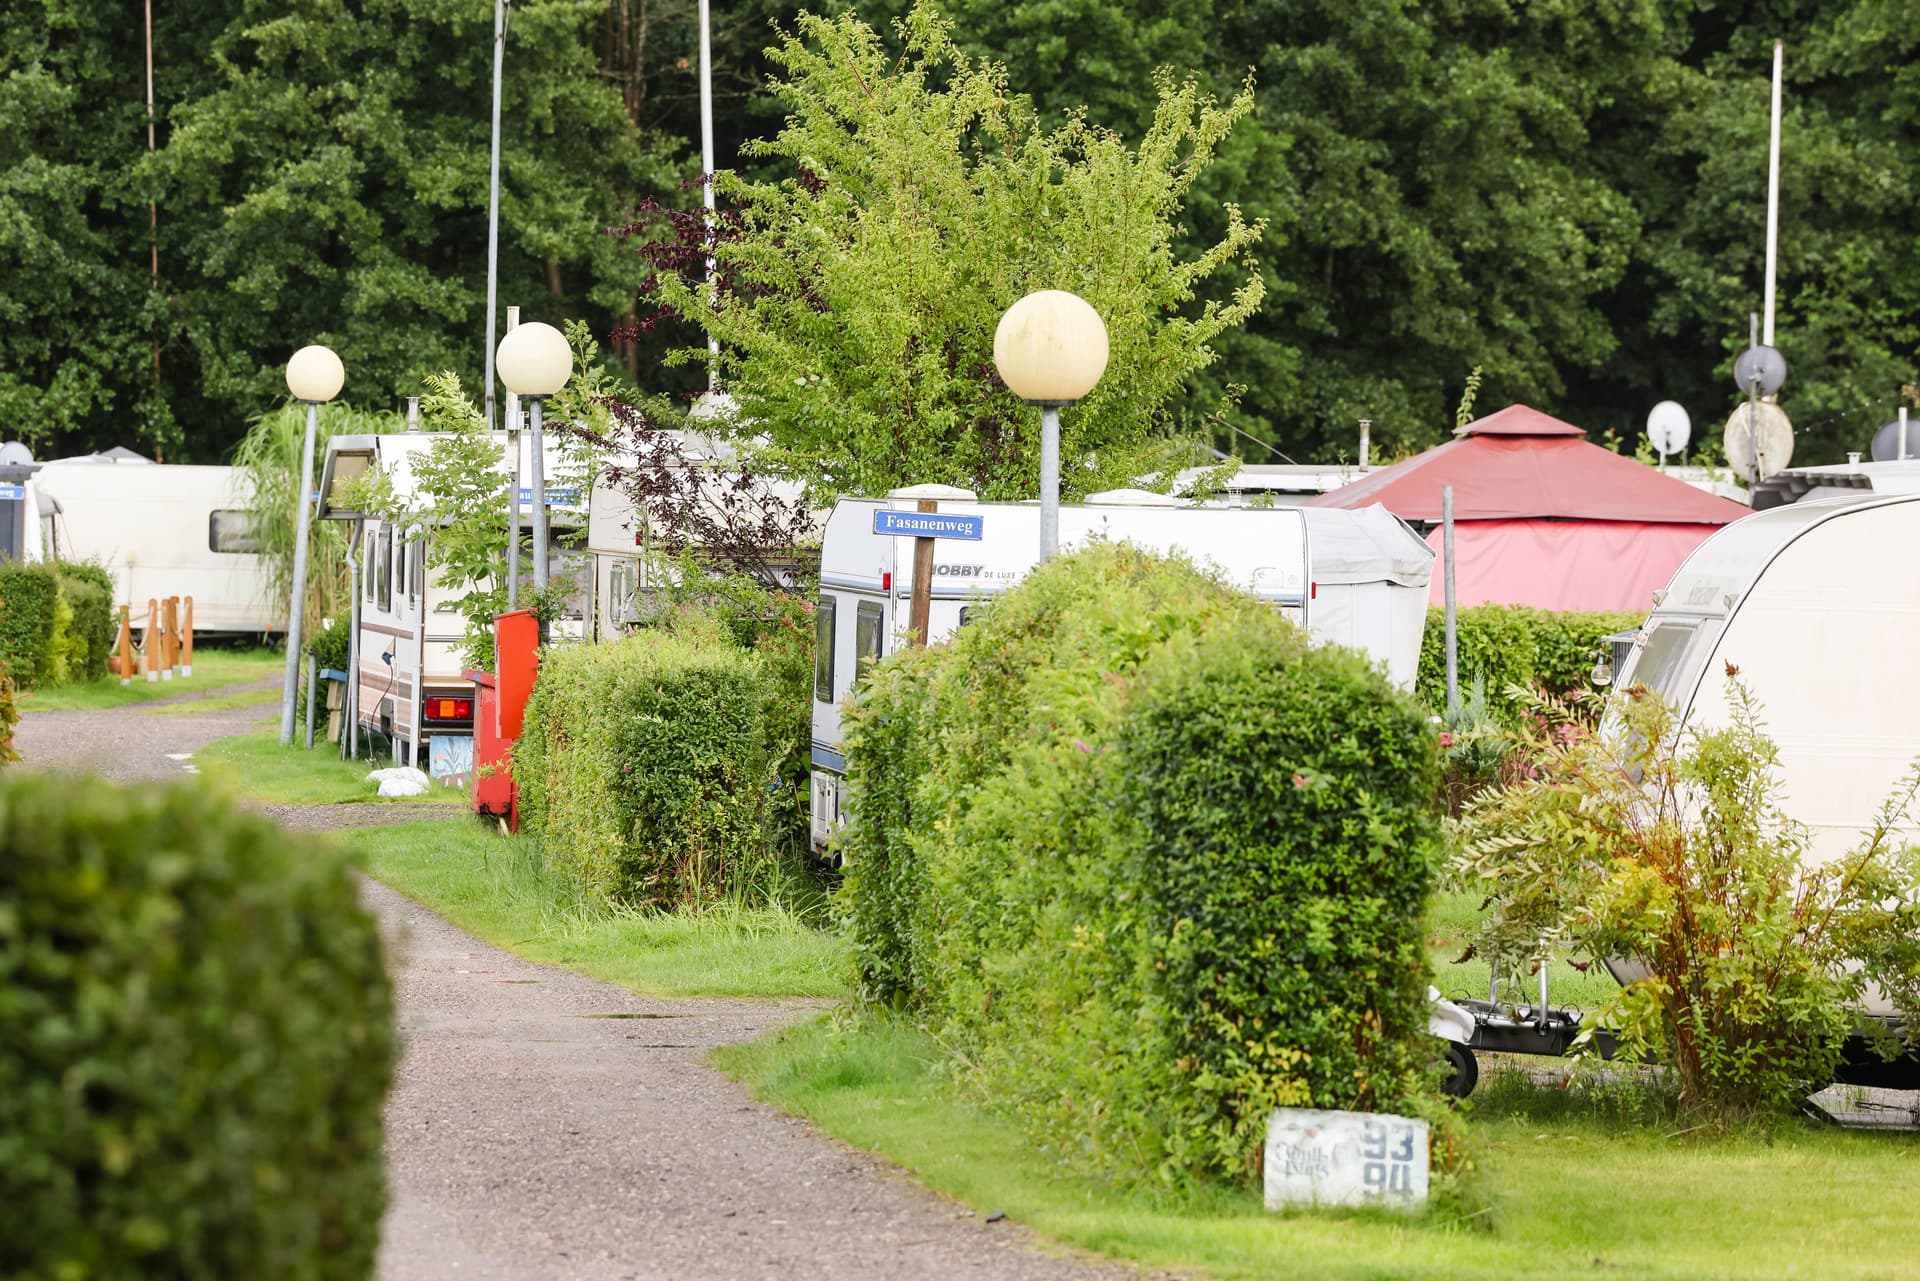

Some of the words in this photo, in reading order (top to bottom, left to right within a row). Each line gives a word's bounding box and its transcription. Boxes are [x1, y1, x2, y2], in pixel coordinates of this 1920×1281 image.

[886, 515, 973, 535] Fasanenweg
[1364, 1121, 1414, 1161] 93
[1363, 1162, 1414, 1201] 94
